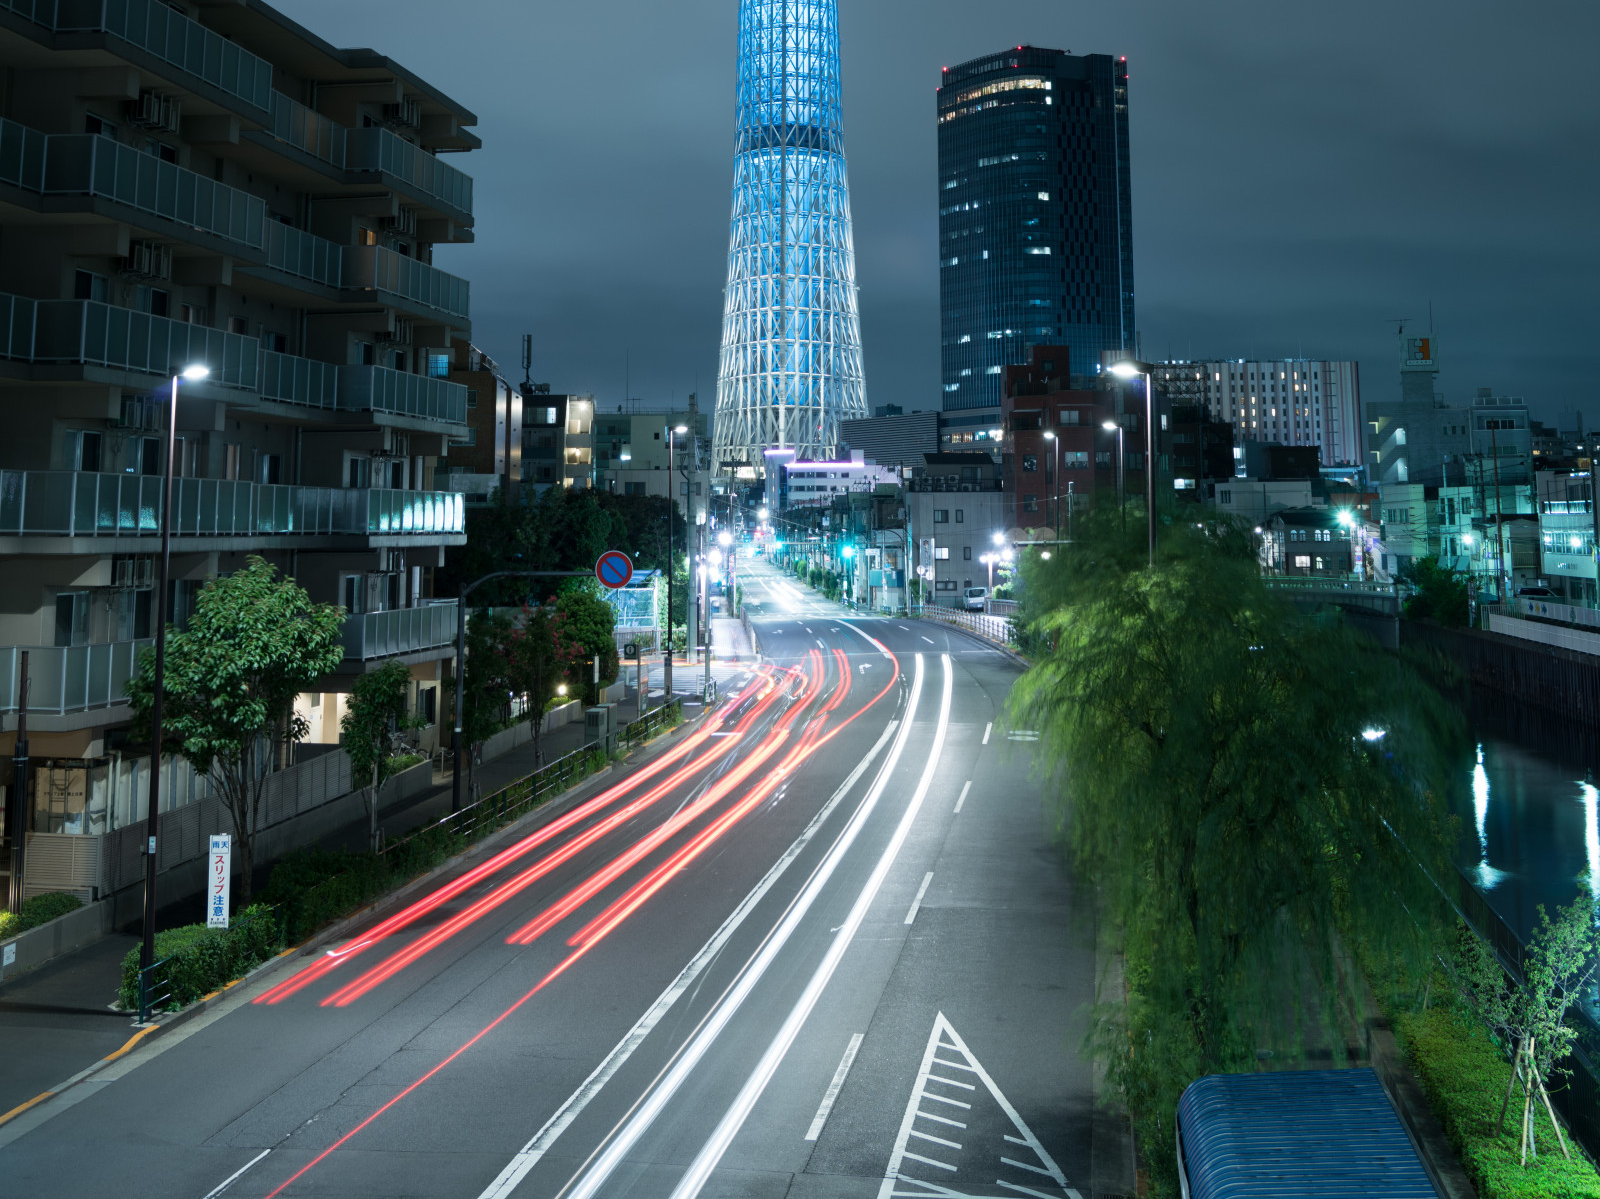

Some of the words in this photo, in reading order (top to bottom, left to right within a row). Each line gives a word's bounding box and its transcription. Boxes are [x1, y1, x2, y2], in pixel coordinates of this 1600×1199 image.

[212, 840, 229, 849] 雨天
[212, 855, 225, 917] スリップ注意
